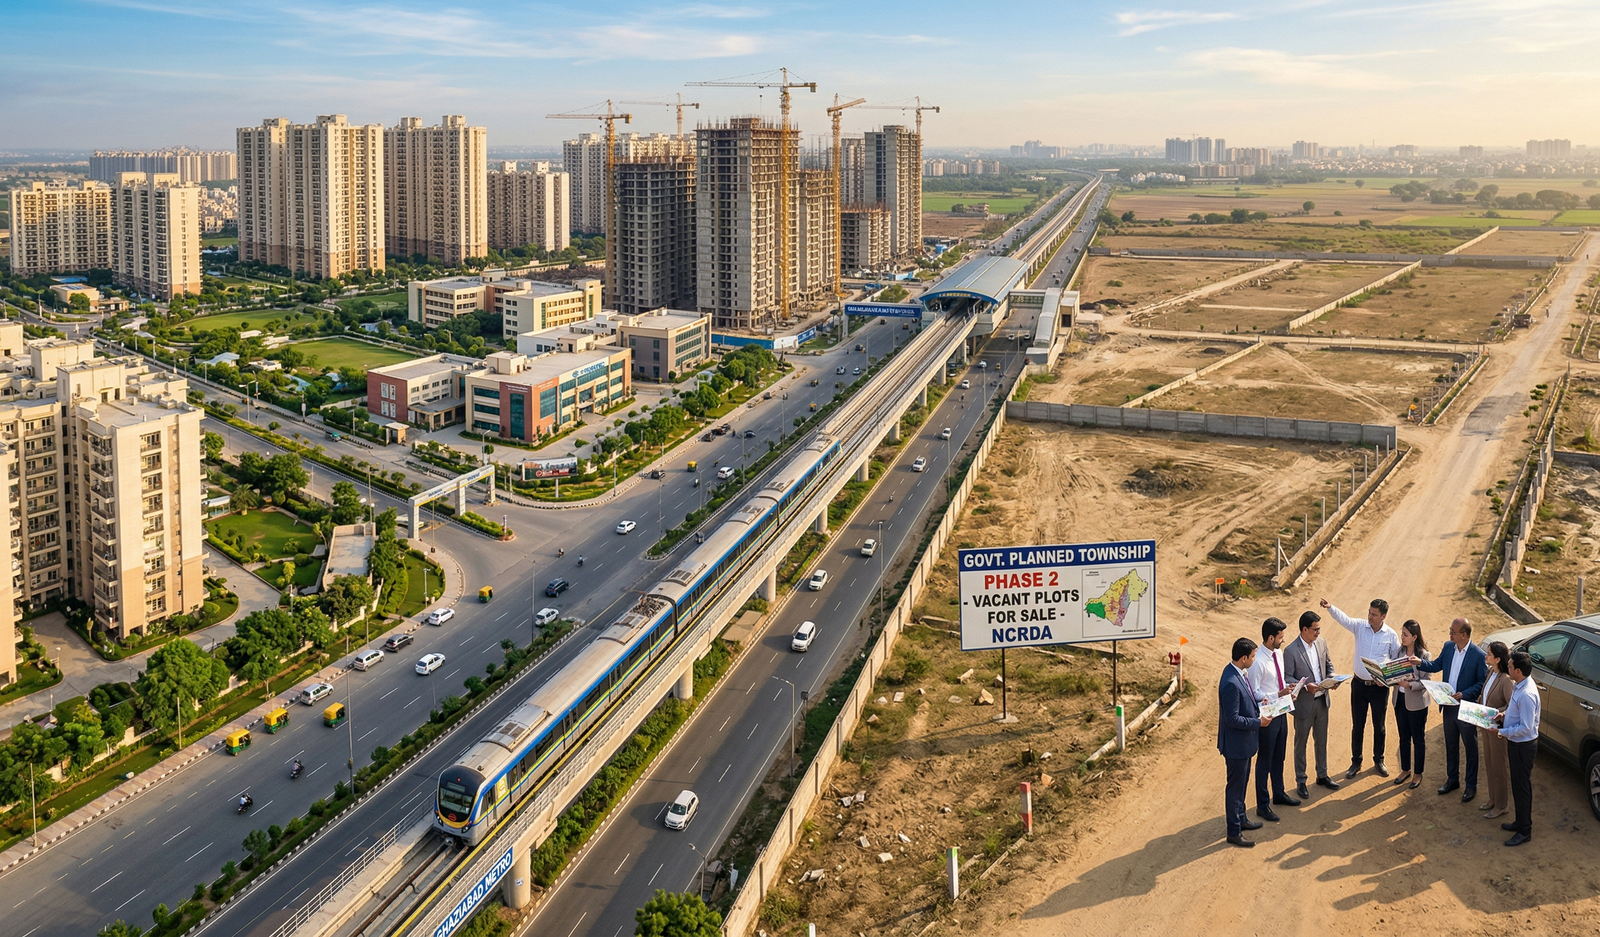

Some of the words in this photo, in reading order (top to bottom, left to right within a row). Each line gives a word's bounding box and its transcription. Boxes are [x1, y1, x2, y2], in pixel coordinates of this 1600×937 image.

[964, 552, 1005, 568] GOVT.
[1009, 549, 1074, 566] PLANNED
[1078, 545, 1151, 562] TOWNSHIP
[984, 572, 1043, 590] PHASE
[1048, 571, 1059, 586] 2
[972, 592, 1031, 608] VACANT
[1035, 589, 1080, 605] PLOTS
[988, 610, 1016, 624] FOR
[1020, 608, 1056, 622] SALE
[992, 625, 1053, 643] NCRDA
[436, 885, 484, 937] GHAZIABAD
[485, 852, 511, 891] METRO
